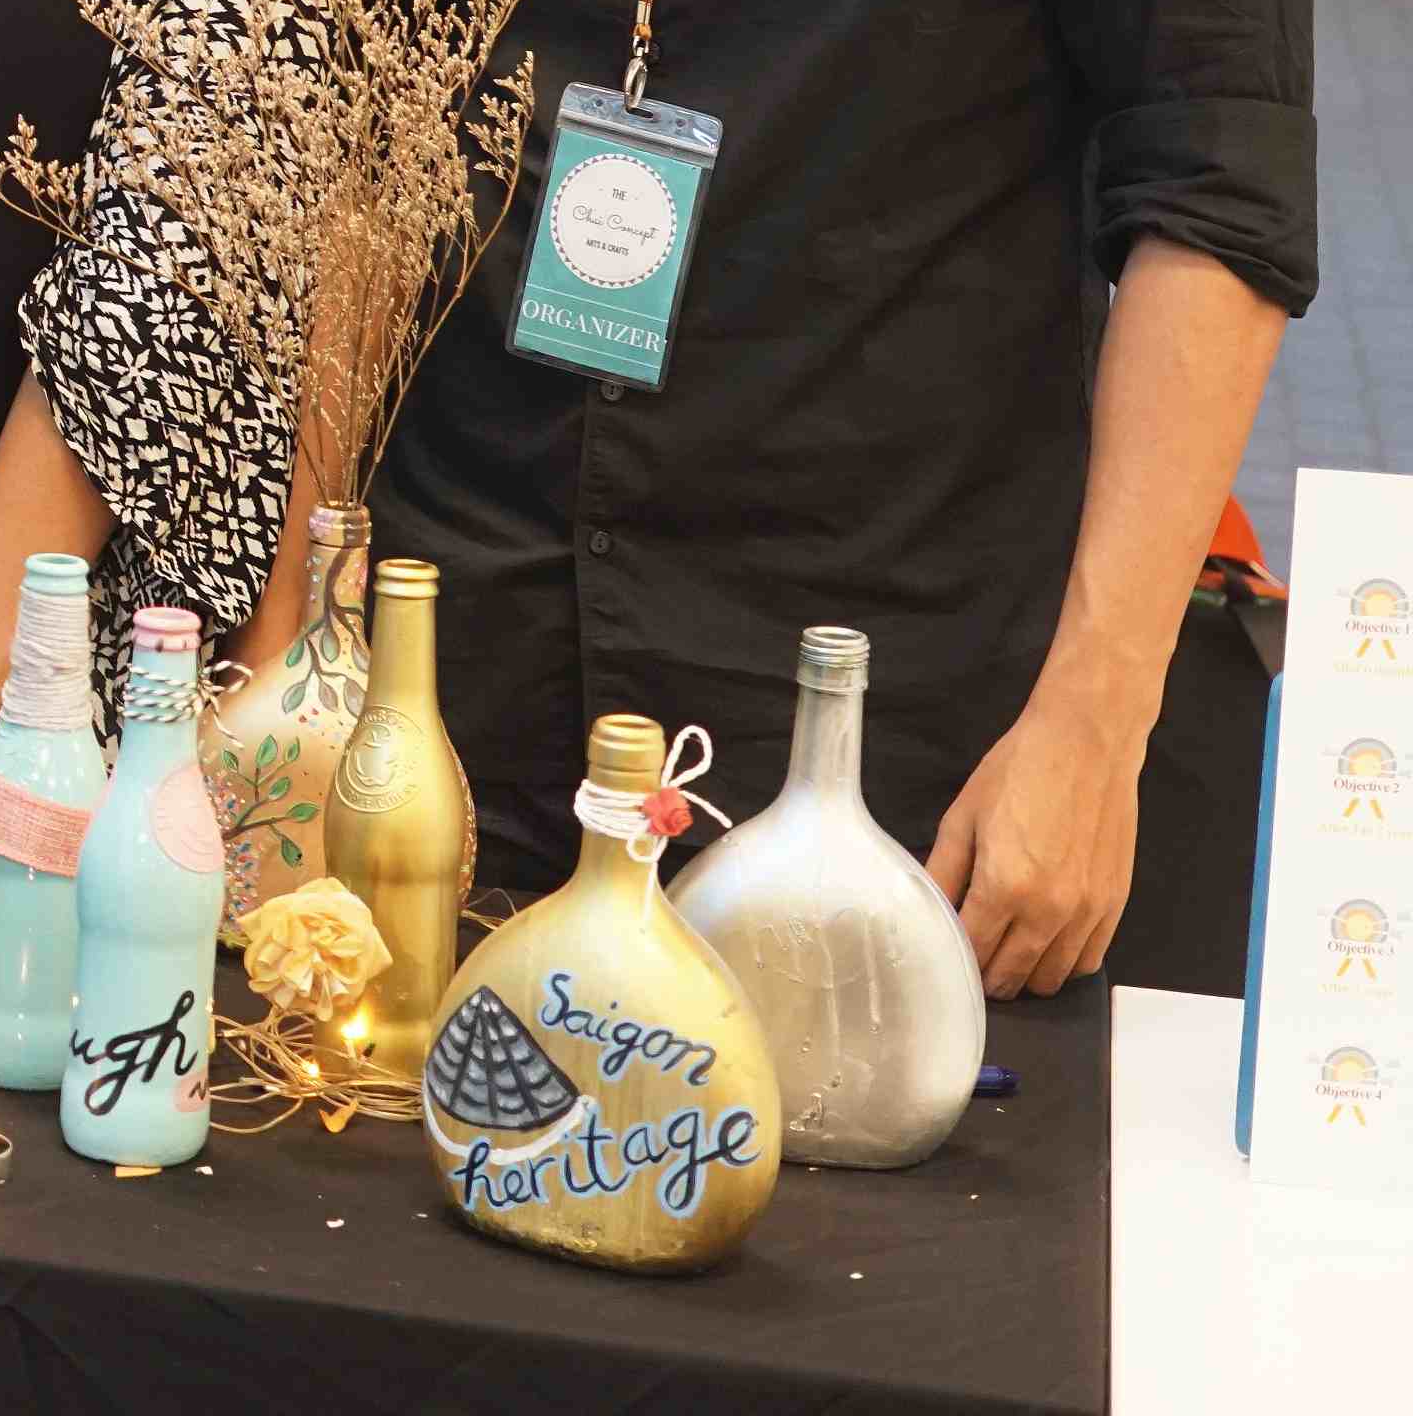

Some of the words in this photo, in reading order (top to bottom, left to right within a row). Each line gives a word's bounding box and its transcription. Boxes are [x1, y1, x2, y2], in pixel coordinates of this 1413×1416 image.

[522, 299, 661, 353] ORGANIZER
[539, 971, 719, 1086] Saigon
[452, 1109, 762, 1212] heritage
